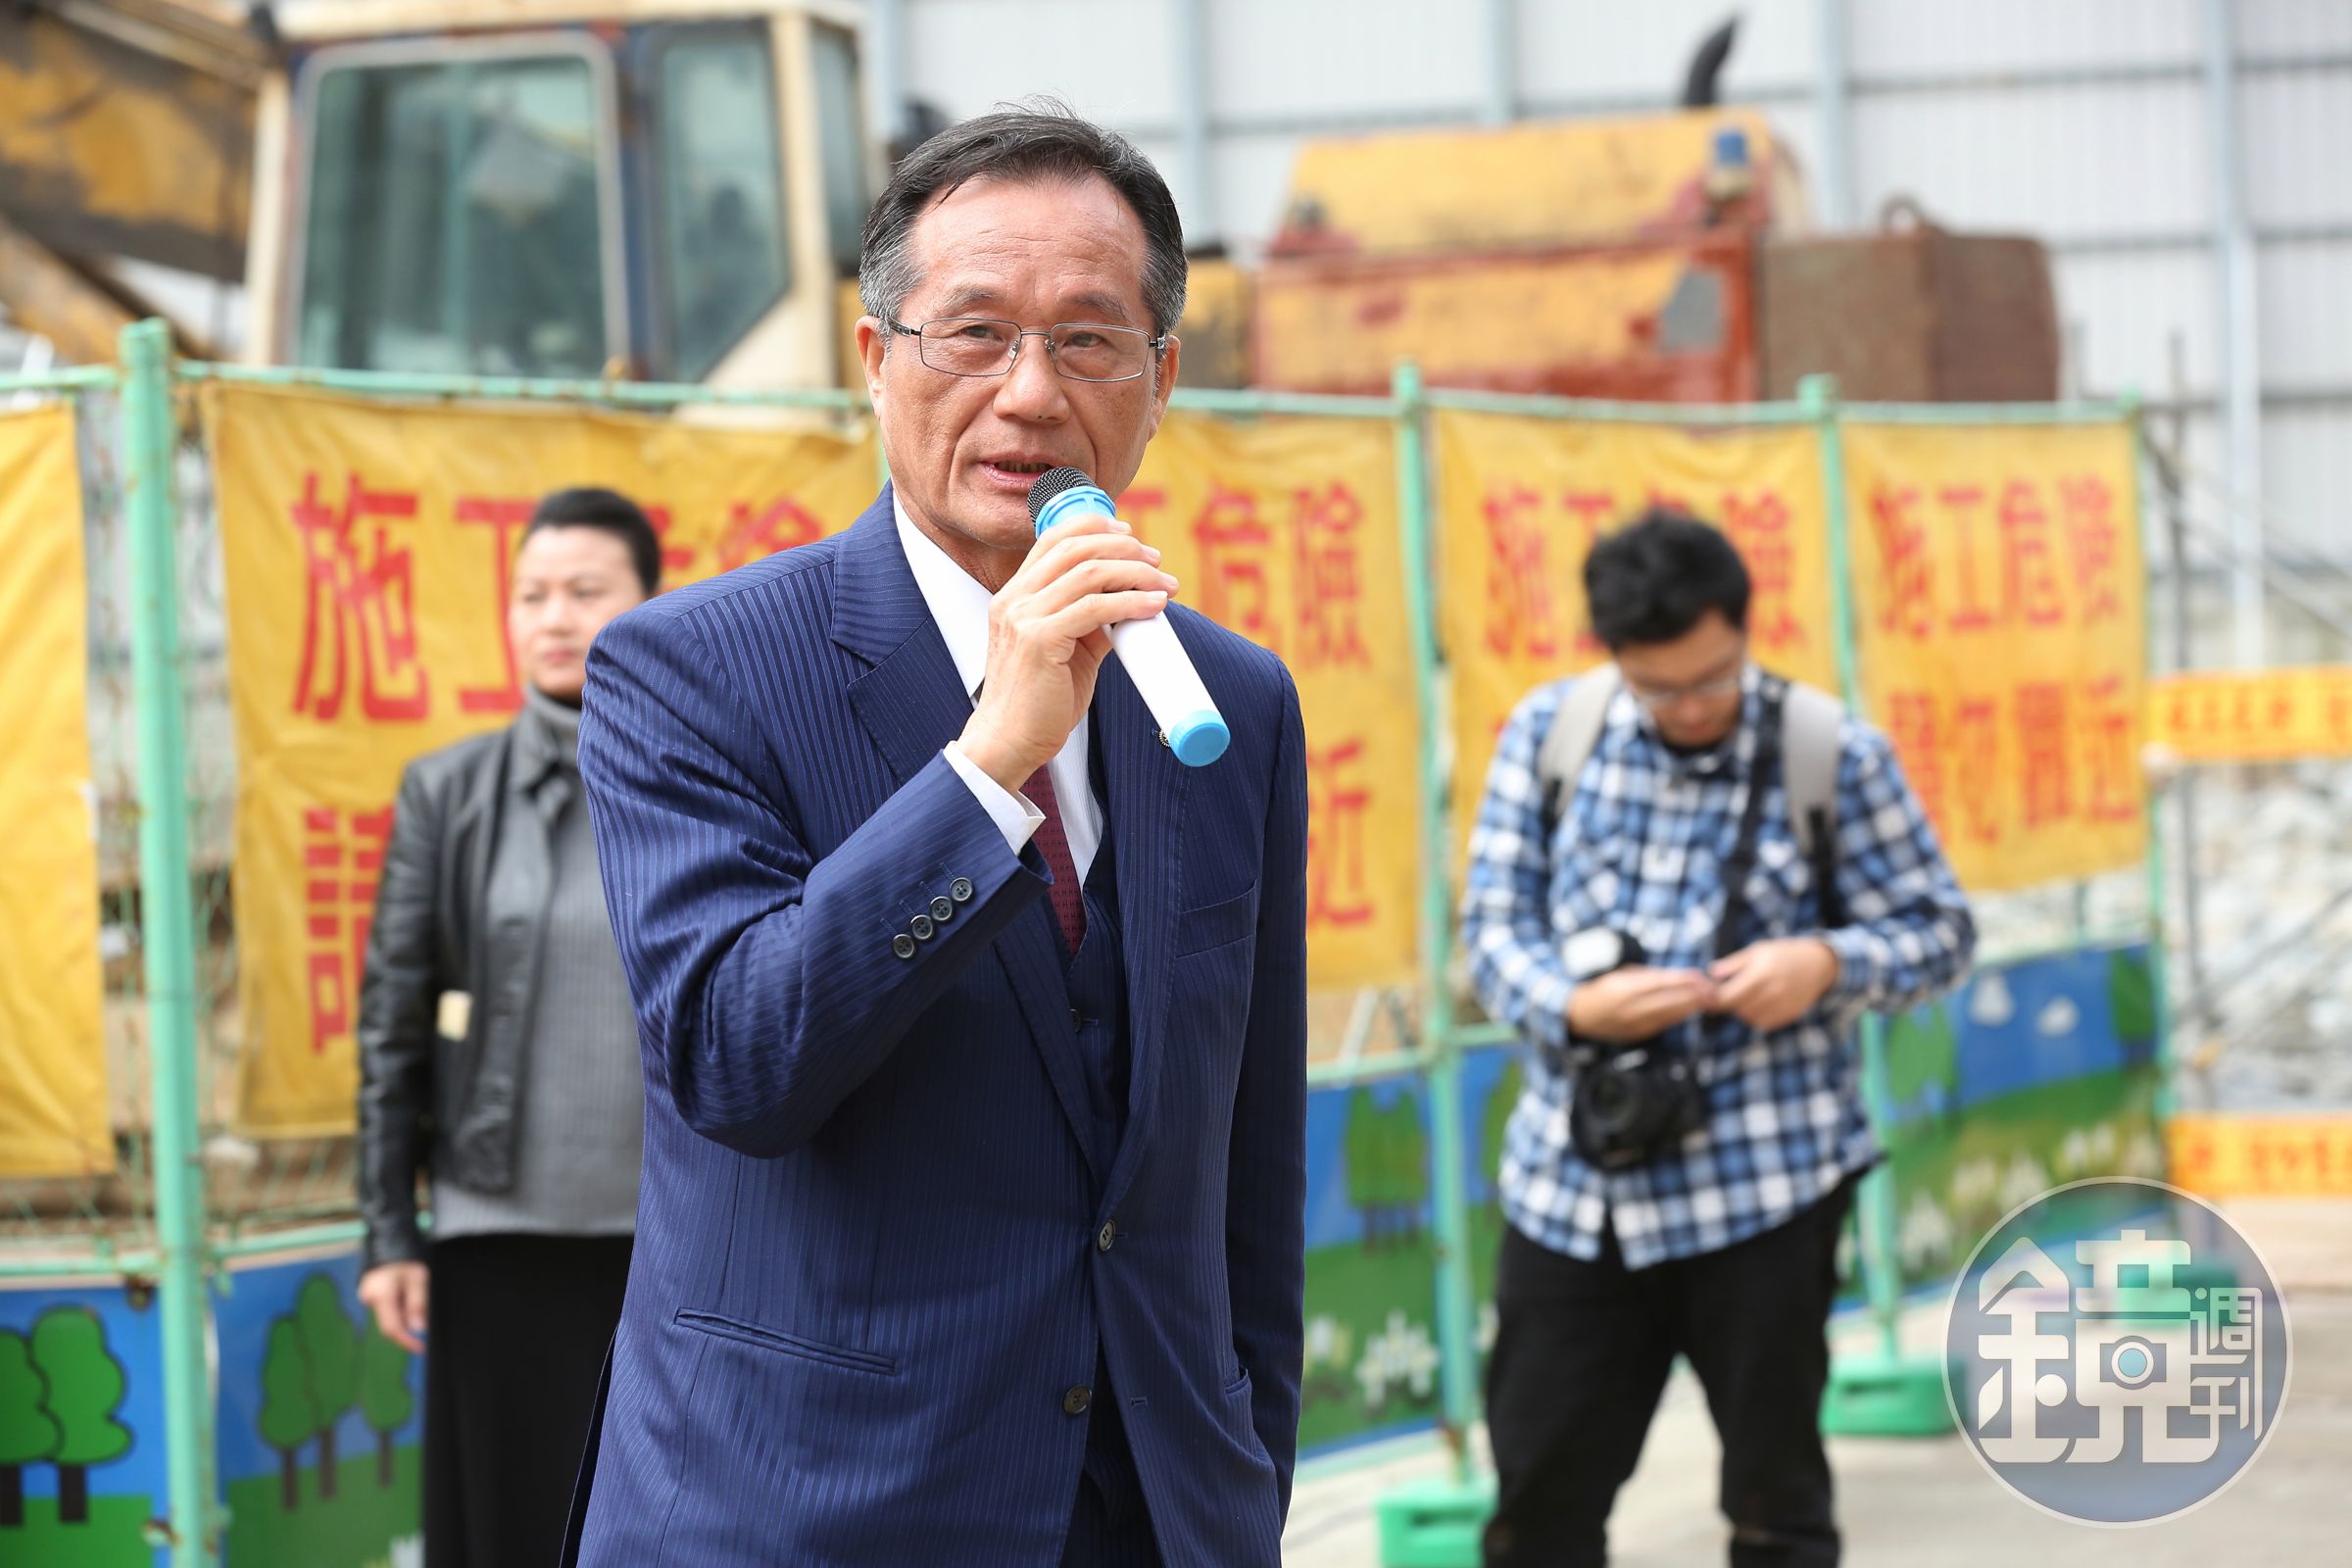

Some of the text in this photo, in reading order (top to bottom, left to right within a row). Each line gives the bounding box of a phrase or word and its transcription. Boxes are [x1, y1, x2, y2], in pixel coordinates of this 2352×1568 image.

[290, 468, 825, 723] 施工
[1482, 480, 1805, 659] 施工險
[1869, 474, 2121, 643] 施工危險
